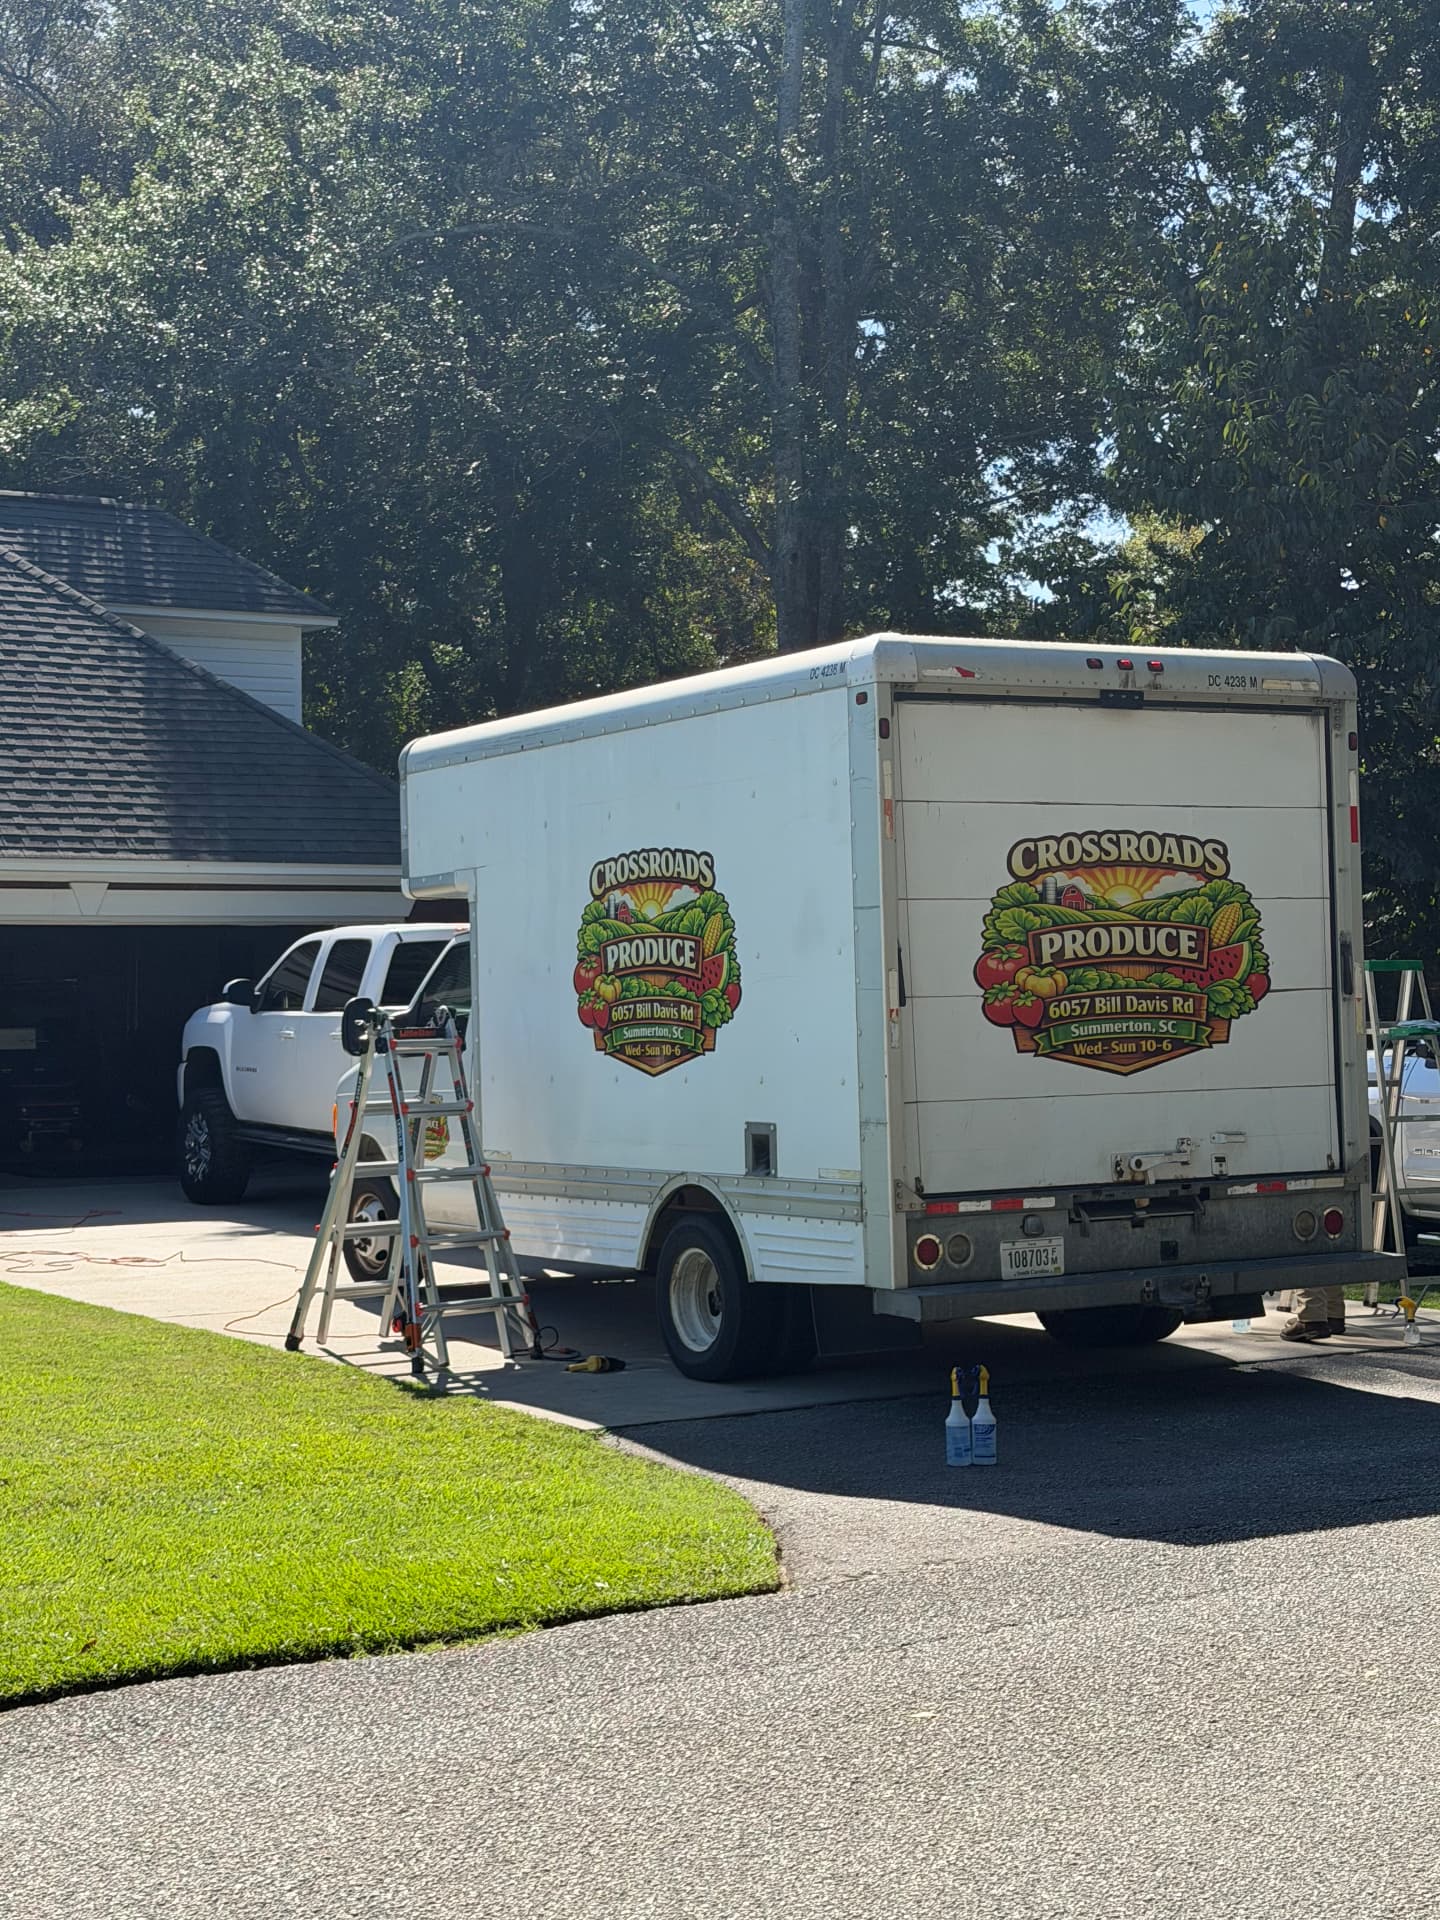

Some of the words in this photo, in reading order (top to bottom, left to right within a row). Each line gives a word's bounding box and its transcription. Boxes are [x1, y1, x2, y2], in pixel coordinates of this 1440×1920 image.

[810, 666, 820, 680] DC
[1208, 674, 1221, 687] DC
[1224, 675, 1247, 688] 4238
[1249, 676, 1257, 689] M
[1011, 834, 1227, 877] CROSSROADS
[592, 851, 713, 895] CROSSROADS
[606, 937, 697, 972] PRODUCE
[1039, 925, 1199, 965] PRODUCE
[611, 1004, 634, 1022] 6057
[636, 1003, 651, 1019] Bill
[653, 1002, 679, 1019] Davis
[680, 1004, 694, 1021] Rd
[1049, 999, 1091, 1018] 6057
[1094, 996, 1121, 1015] Bill
[1125, 995, 1169, 1013] Davis
[1172, 996, 1194, 1014] Rd
[623, 1025, 672, 1040] Summerton,
[672, 1026, 684, 1040] SC
[1070, 1020, 1156, 1038] Summerton,
[1159, 1019, 1177, 1034] SC
[662, 1043, 681, 1056] 10-6
[1140, 1039, 1172, 1052] 10-6
[1008, 1248, 1049, 1269] 108703
